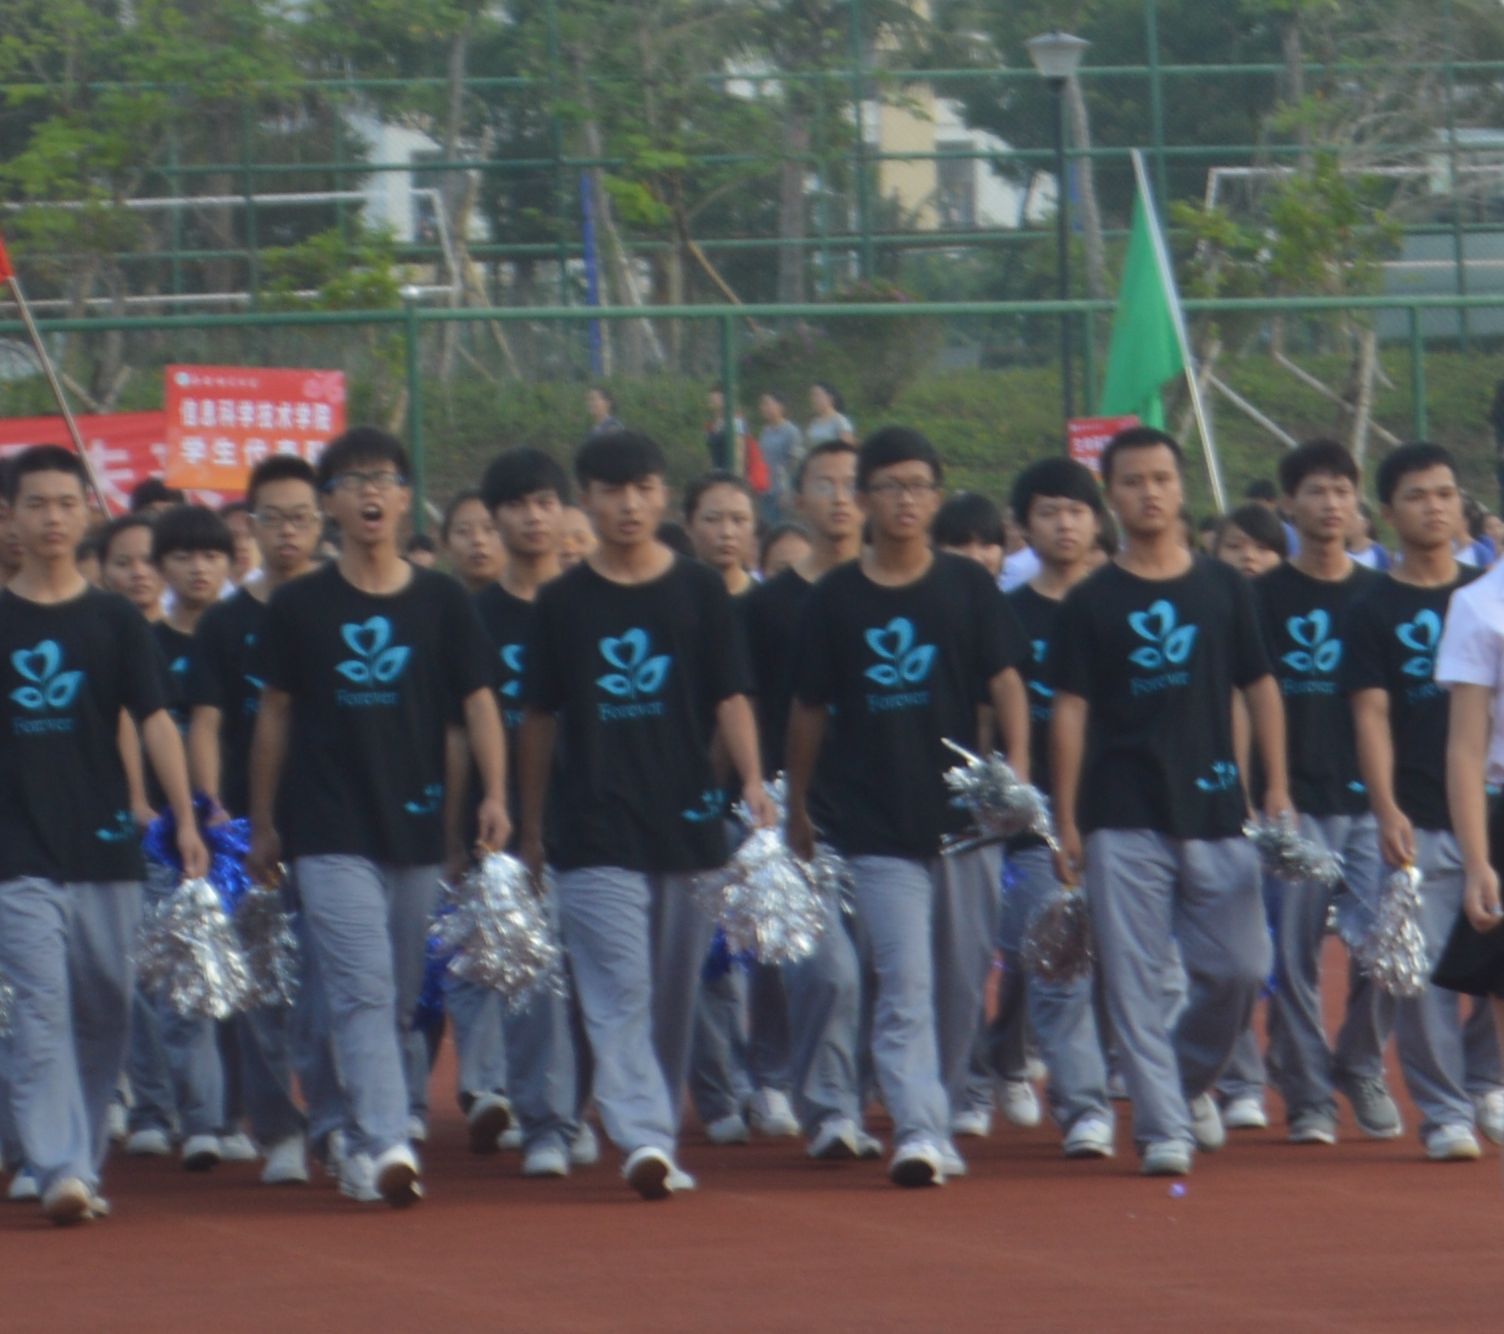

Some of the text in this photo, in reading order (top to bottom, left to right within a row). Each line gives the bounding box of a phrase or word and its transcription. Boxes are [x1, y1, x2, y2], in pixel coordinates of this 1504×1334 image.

[180, 397, 331, 431] 信息科学技术学院
[336, 689, 398, 707] Forever
